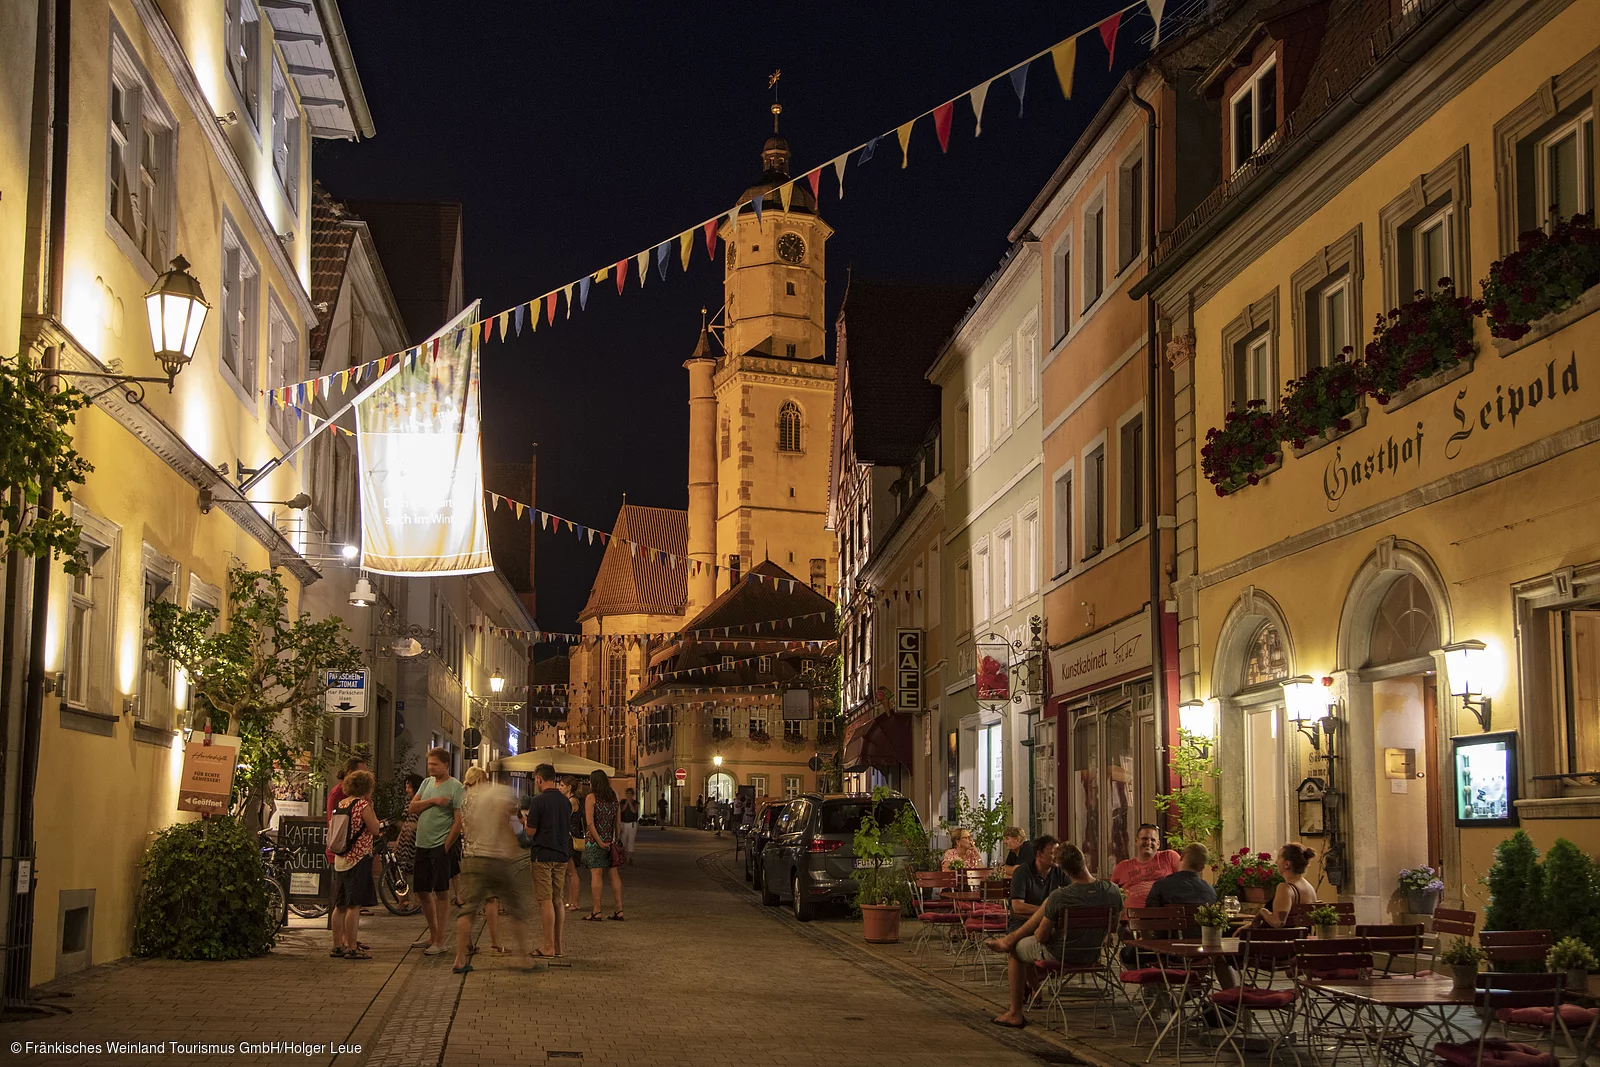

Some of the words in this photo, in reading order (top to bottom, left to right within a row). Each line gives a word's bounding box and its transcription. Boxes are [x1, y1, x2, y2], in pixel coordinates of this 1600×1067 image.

[1323, 420, 1424, 512] Gasthof
[1444, 350, 1580, 460] Leipold
[900, 633, 917, 707] CAFE
[1061, 648, 1108, 680] Kunstkabinett
[192, 797, 223, 807] Geöffnet
